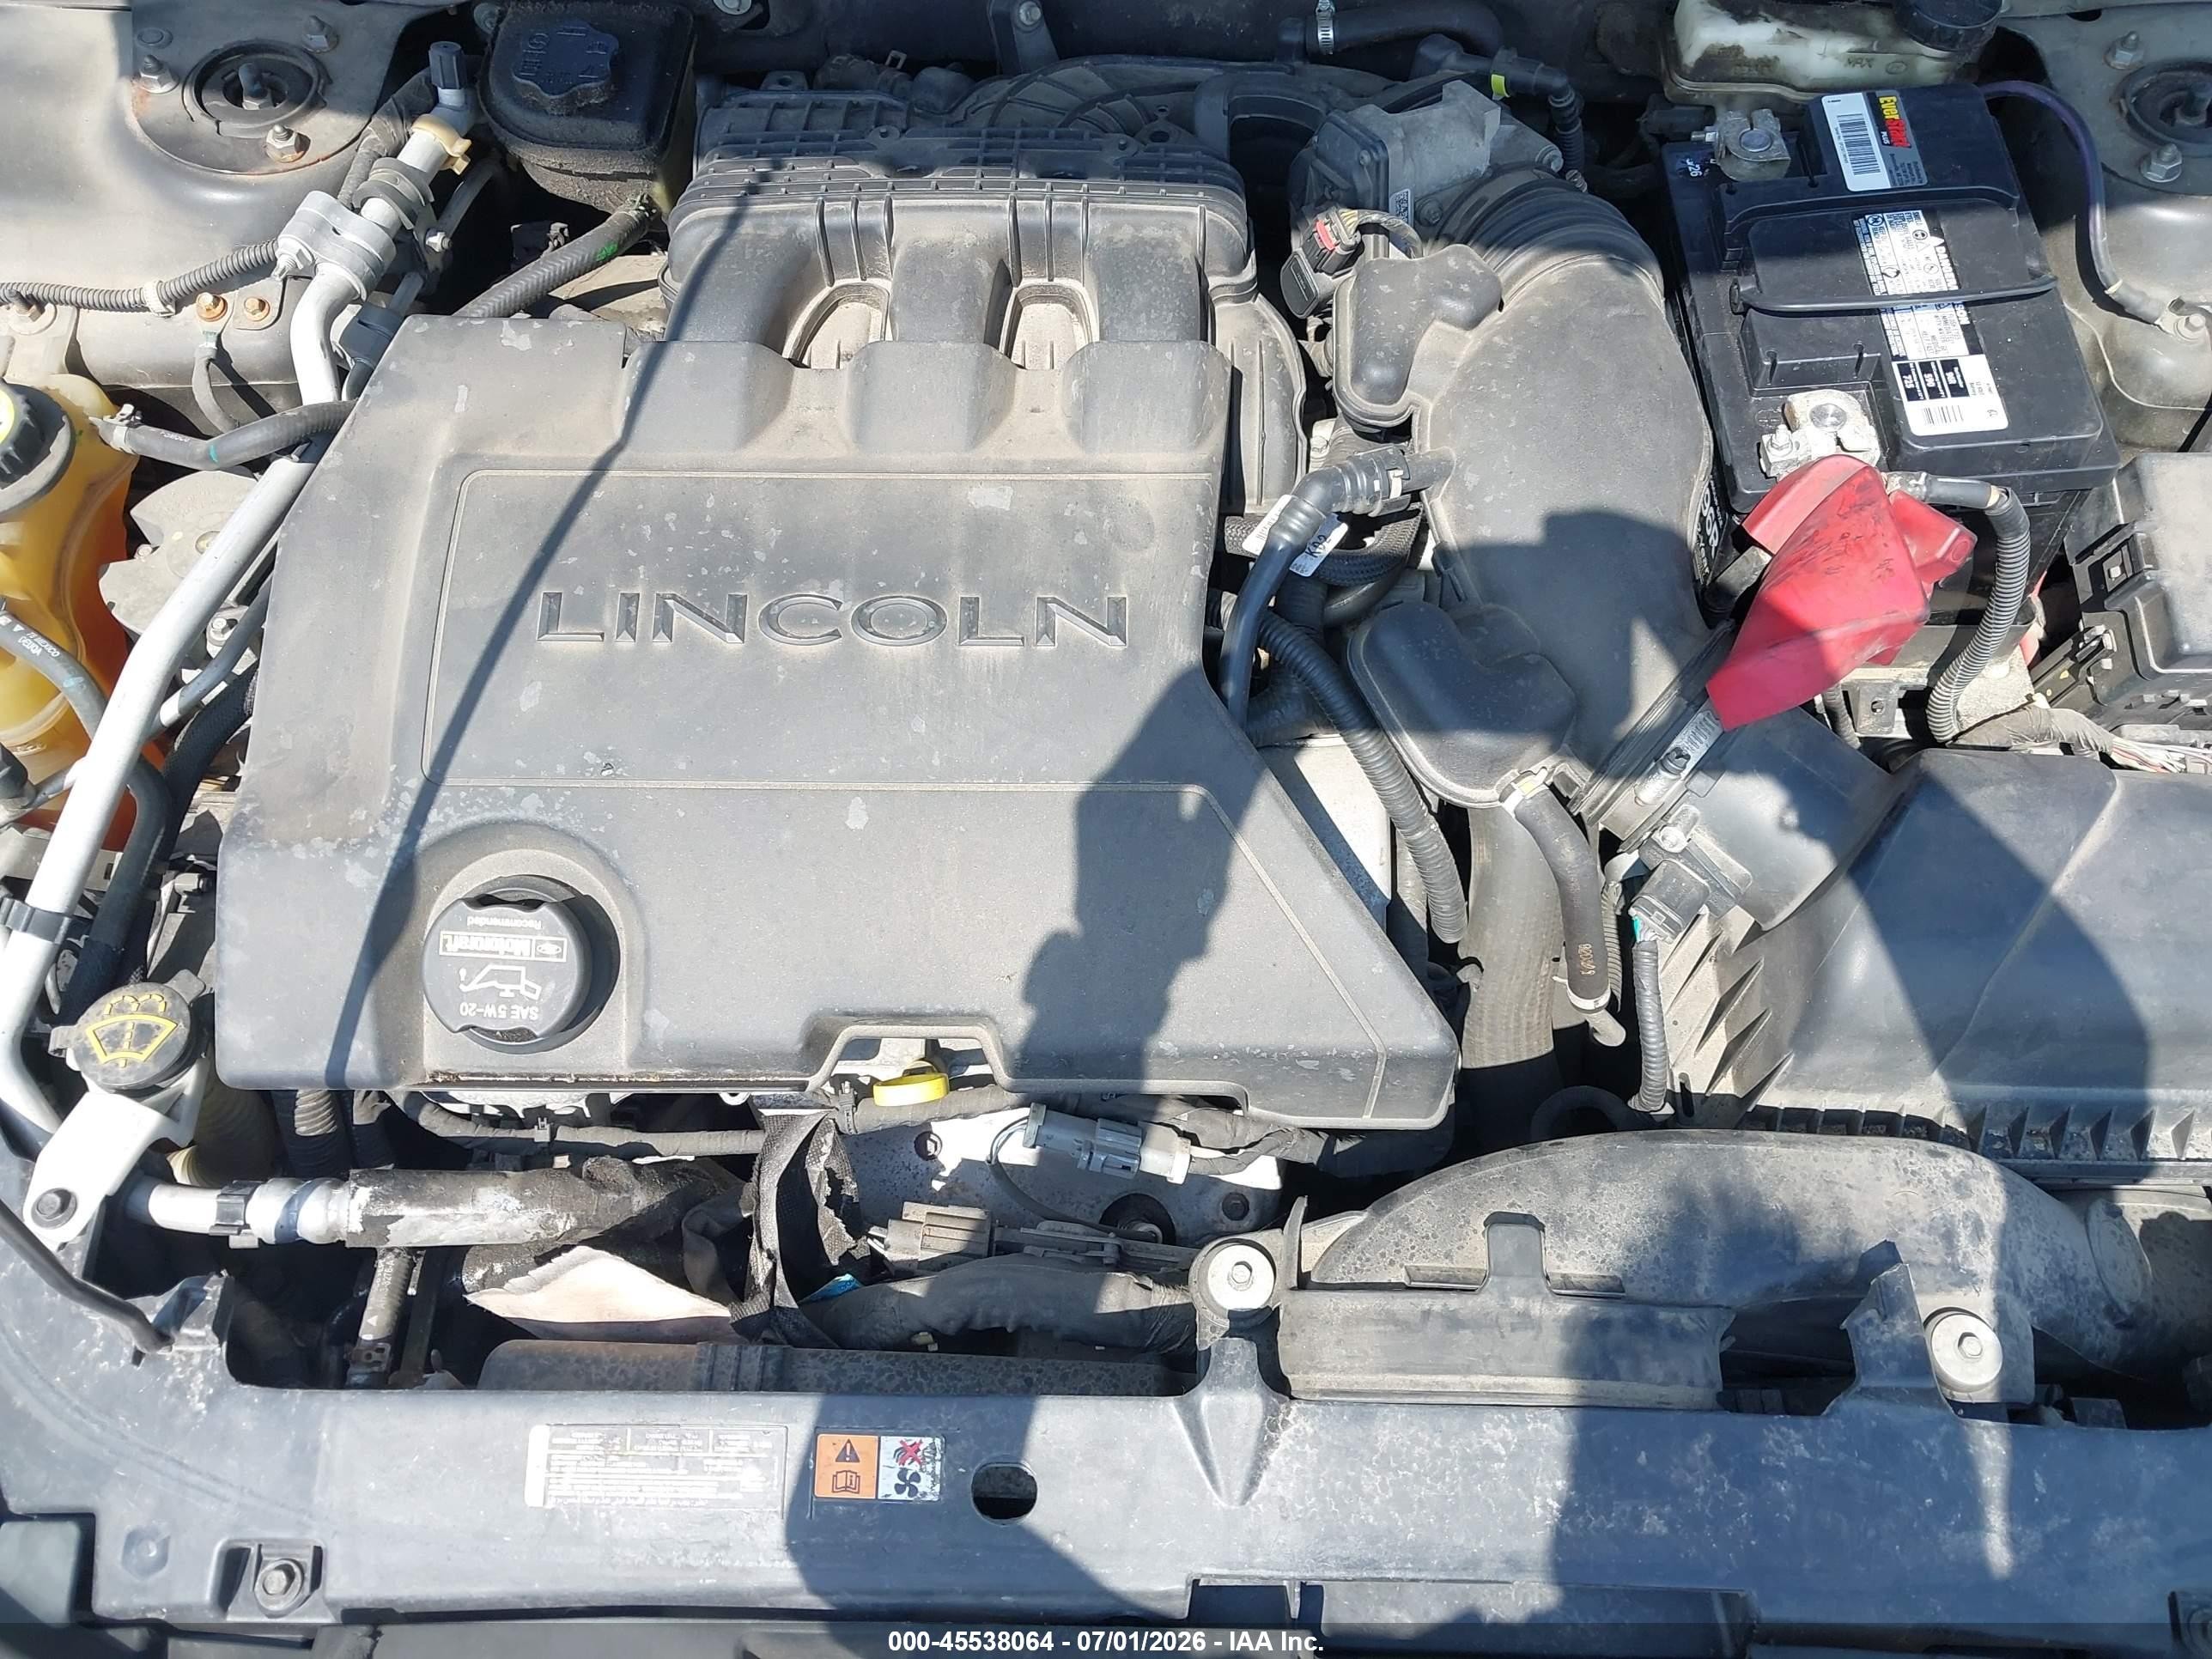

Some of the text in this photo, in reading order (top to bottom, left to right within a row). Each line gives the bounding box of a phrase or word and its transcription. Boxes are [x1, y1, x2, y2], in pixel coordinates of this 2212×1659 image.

[1878, 94, 1911, 148] EverStart
[1881, 131, 1890, 144] PLUS
[1903, 374, 1914, 389] 725
[1923, 373, 1936, 387] 590
[1946, 371, 1957, 385] 96R
[1702, 488, 1718, 559] 96R
[537, 592, 1128, 647] LINCOLN
[467, 916, 542, 929] Recommended
[459, 1003, 538, 1020] SAE 5W-20
